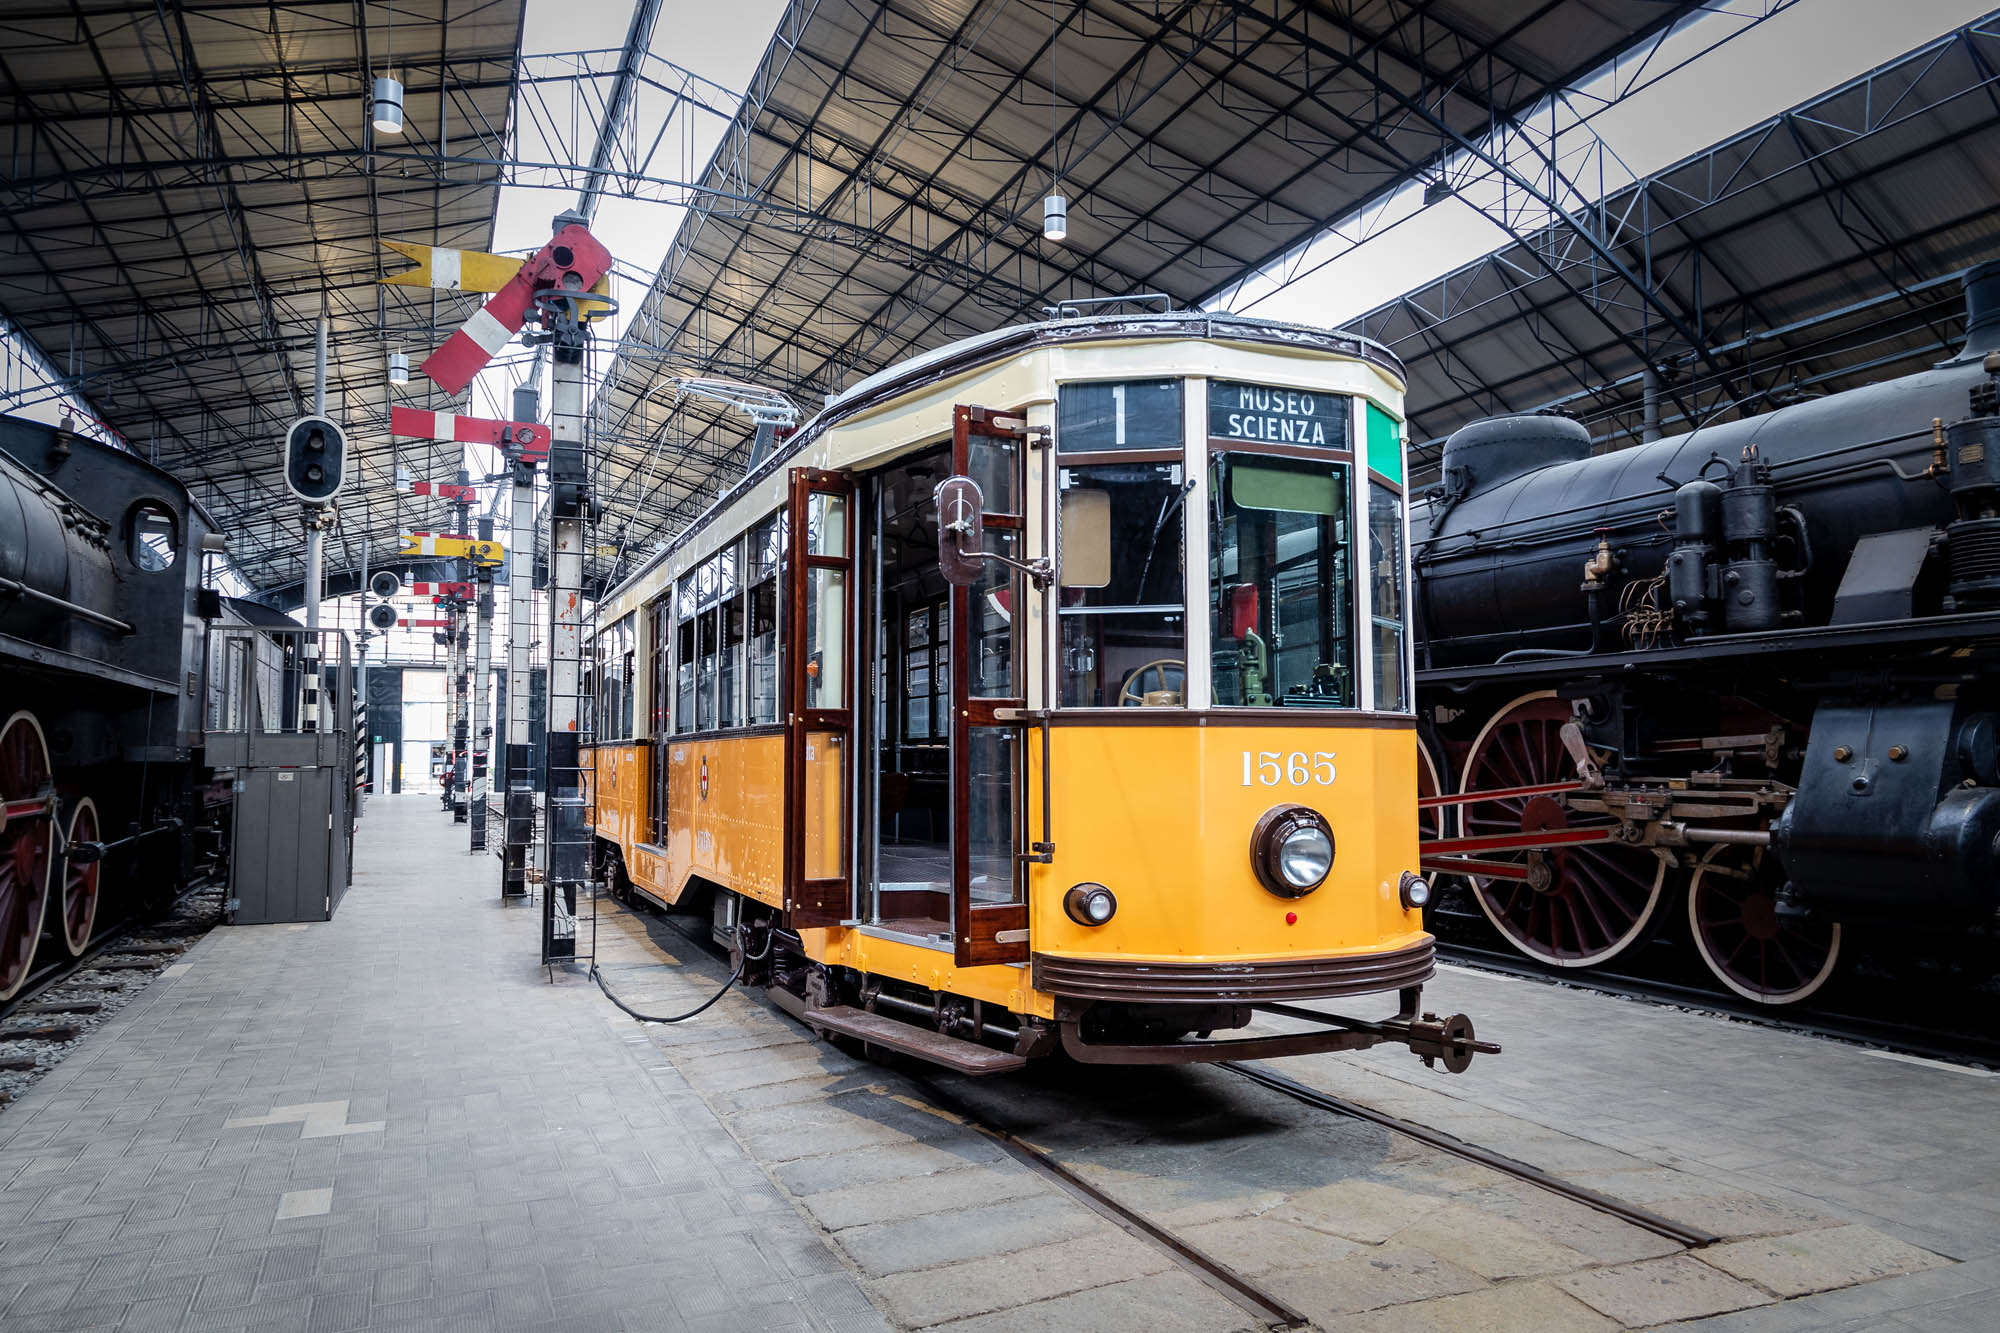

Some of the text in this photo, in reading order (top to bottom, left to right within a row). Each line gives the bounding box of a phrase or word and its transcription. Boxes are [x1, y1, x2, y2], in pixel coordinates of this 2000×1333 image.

[1112, 384, 1126, 445] 1
[1239, 386, 1315, 416] MUSEO
[1228, 413, 1326, 445] SCIENZA
[1240, 751, 1337, 787] 1565
